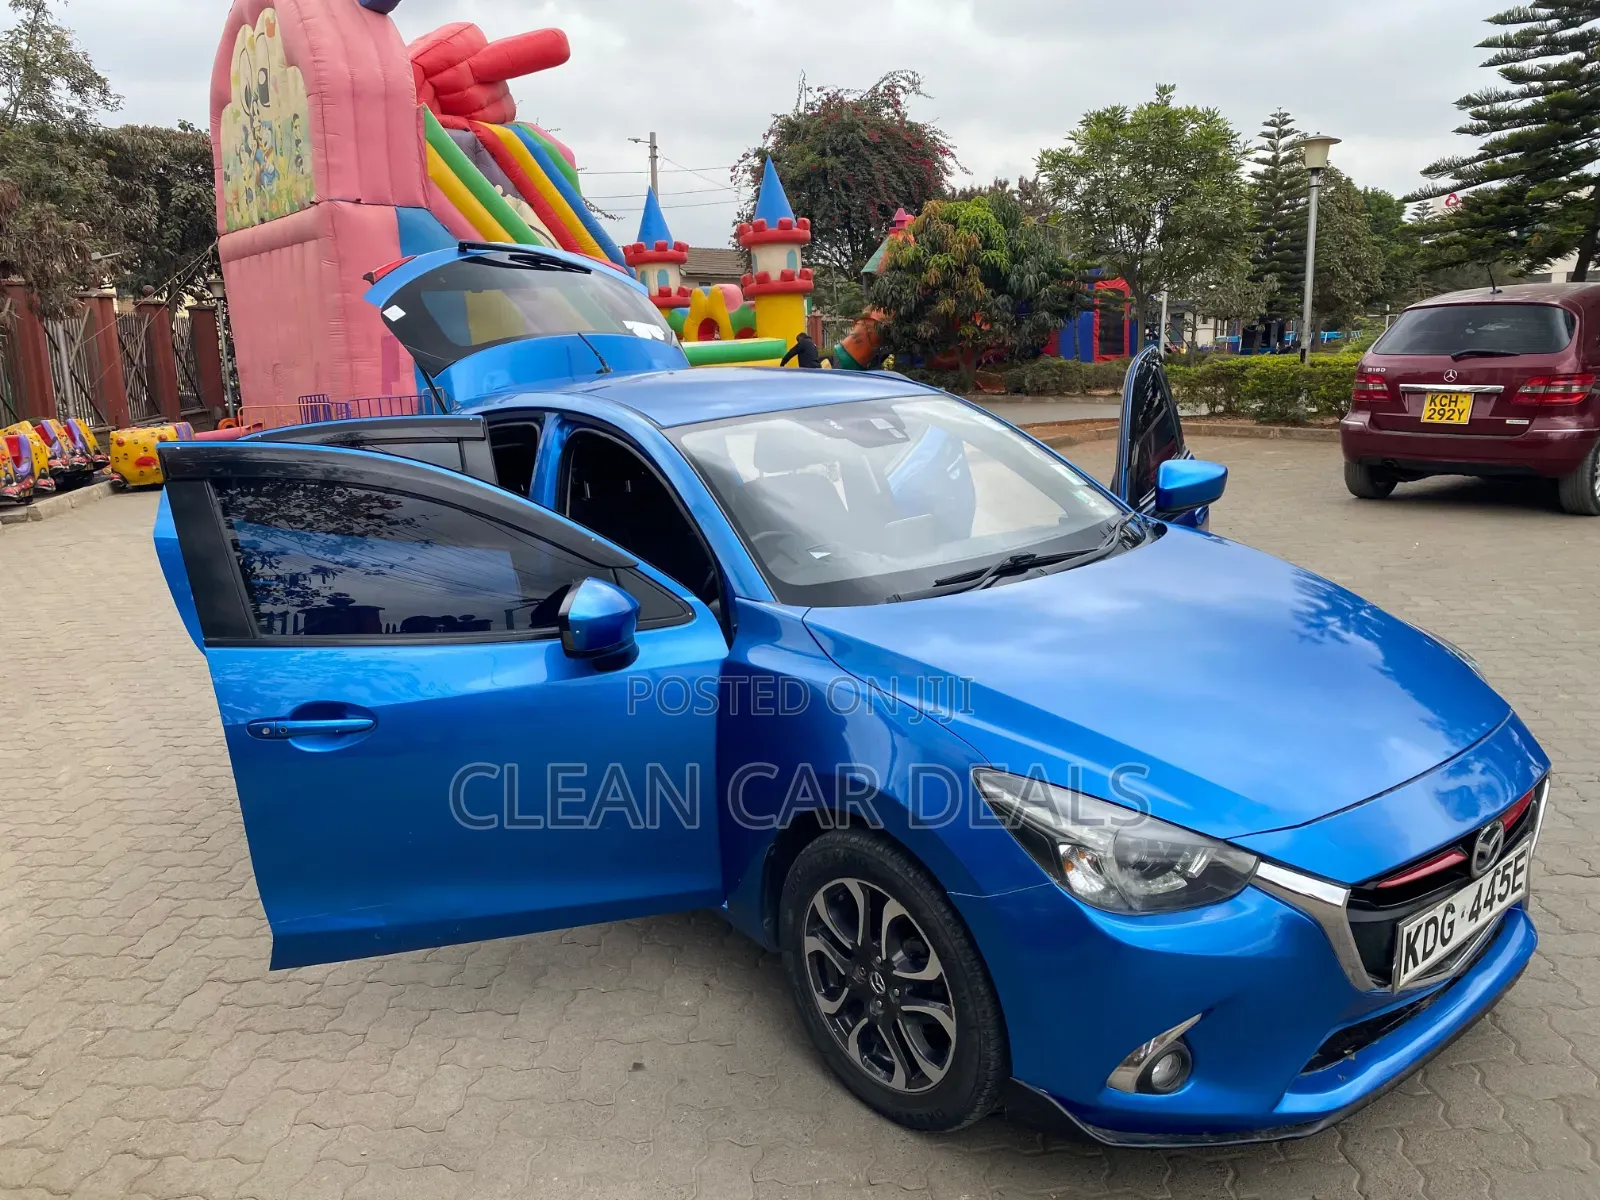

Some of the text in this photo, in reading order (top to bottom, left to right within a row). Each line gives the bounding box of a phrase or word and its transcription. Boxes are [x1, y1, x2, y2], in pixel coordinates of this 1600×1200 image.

[1429, 395, 1459, 407] KCH
[1427, 408, 1466, 421] 292Y
[1403, 851, 1528, 976] KDG 445E
